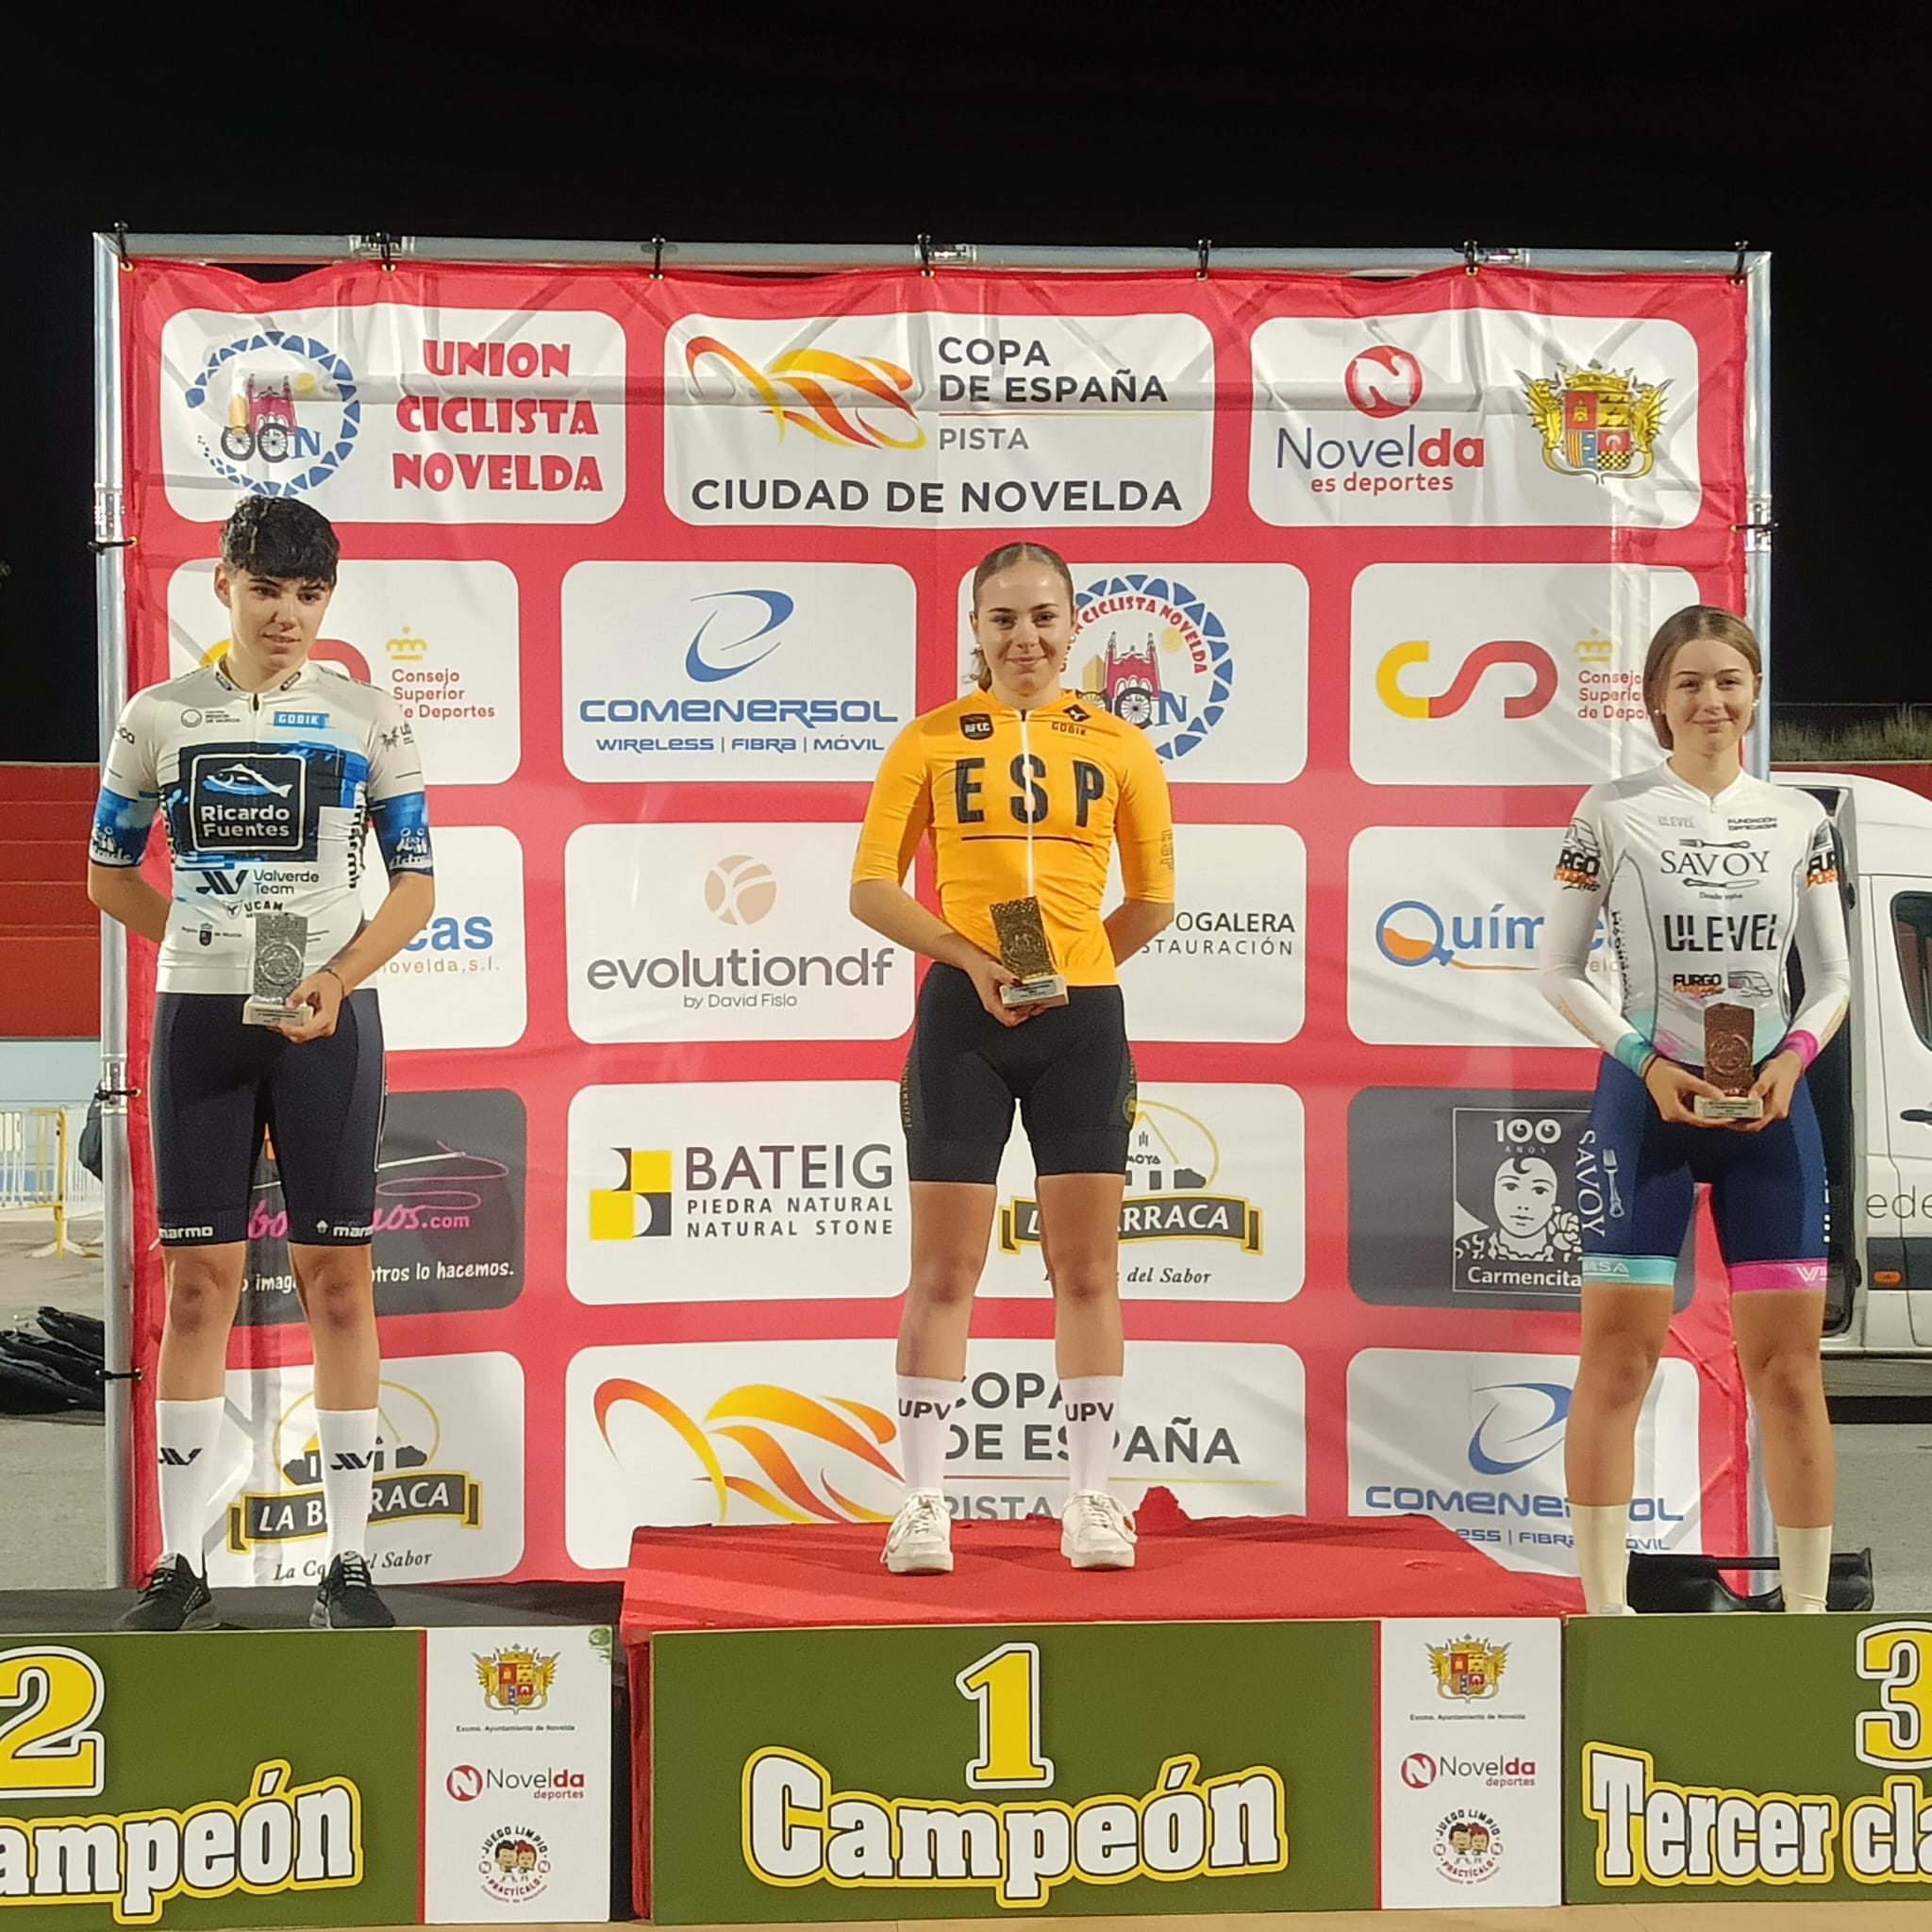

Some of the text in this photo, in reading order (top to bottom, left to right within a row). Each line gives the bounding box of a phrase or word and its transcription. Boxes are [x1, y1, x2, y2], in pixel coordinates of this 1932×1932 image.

[424, 340, 570, 377] UNION
[938, 336, 1050, 367] COPA
[940, 368, 1168, 404] DE ESPAÑA
[395, 394, 599, 435] CICLISTA
[939, 426, 1029, 451] PISTA
[1275, 424, 1485, 470] Novelda
[391, 452, 604, 492] NOVELDA
[1310, 472, 1454, 497] es deportes
[691, 478, 1182, 514] CIUDAD DE NOVELDA
[1081, 596, 1208, 675] CICLISTA NOVELDA
[391, 667, 461, 686] Consejo
[392, 684, 466, 703] Superior
[1578, 687, 1641, 704] Superio
[418, 704, 496, 723] Deportes
[1577, 705, 1648, 722] de Depo
[955, 754, 1105, 828] ESP
[200, 804, 291, 823] Ricardo
[201, 822, 291, 839] Fuentes
[1559, 849, 1601, 875] RGO
[1659, 849, 1771, 877] SAVOY
[252, 868, 321, 884] Valverde
[253, 882, 295, 896] Team
[243, 899, 284, 913] UCAM
[1174, 911, 1295, 934] OGALERA
[586, 947, 895, 991] evolutiondf
[683, 993, 704, 1009] by
[708, 992, 758, 1008] David
[1491, 1118, 1562, 1143] 100
[685, 1142, 893, 1191] BATEIG
[1574, 1128, 1606, 1239] SAVOY
[687, 1196, 893, 1215] PIEDRA NATURAL
[1121, 1203, 1230, 1232] RRACA
[687, 1219, 893, 1238] NATURAL STONE
[415, 1261, 431, 1279] lo
[436, 1259, 515, 1281] hacemos.
[1126, 1266, 1212, 1285] del Sabor
[1467, 1265, 1583, 1288] Carmencita
[898, 1398, 953, 1422] UPV
[1064, 1400, 1114, 1423] UPV
[258, 1504, 295, 1532] LA
[274, 1563, 295, 1581] La
[381, 1548, 432, 1570] Sabor
[1857, 1621, 1932, 1770] 3
[0, 1647, 103, 1797] 2
[957, 1643, 1053, 1788] 1
[1440, 1754, 1536, 1776] Novelda
[487, 1767, 585, 1790] Novelda
[1485, 1776, 1536, 1788] deportes
[533, 1789, 584, 1801] deportes
[1586, 1746, 1835, 1882] Tercer
[481, 1824, 549, 1855] JUEGO LIMPIO
[745, 1750, 1285, 1904] Campeón
